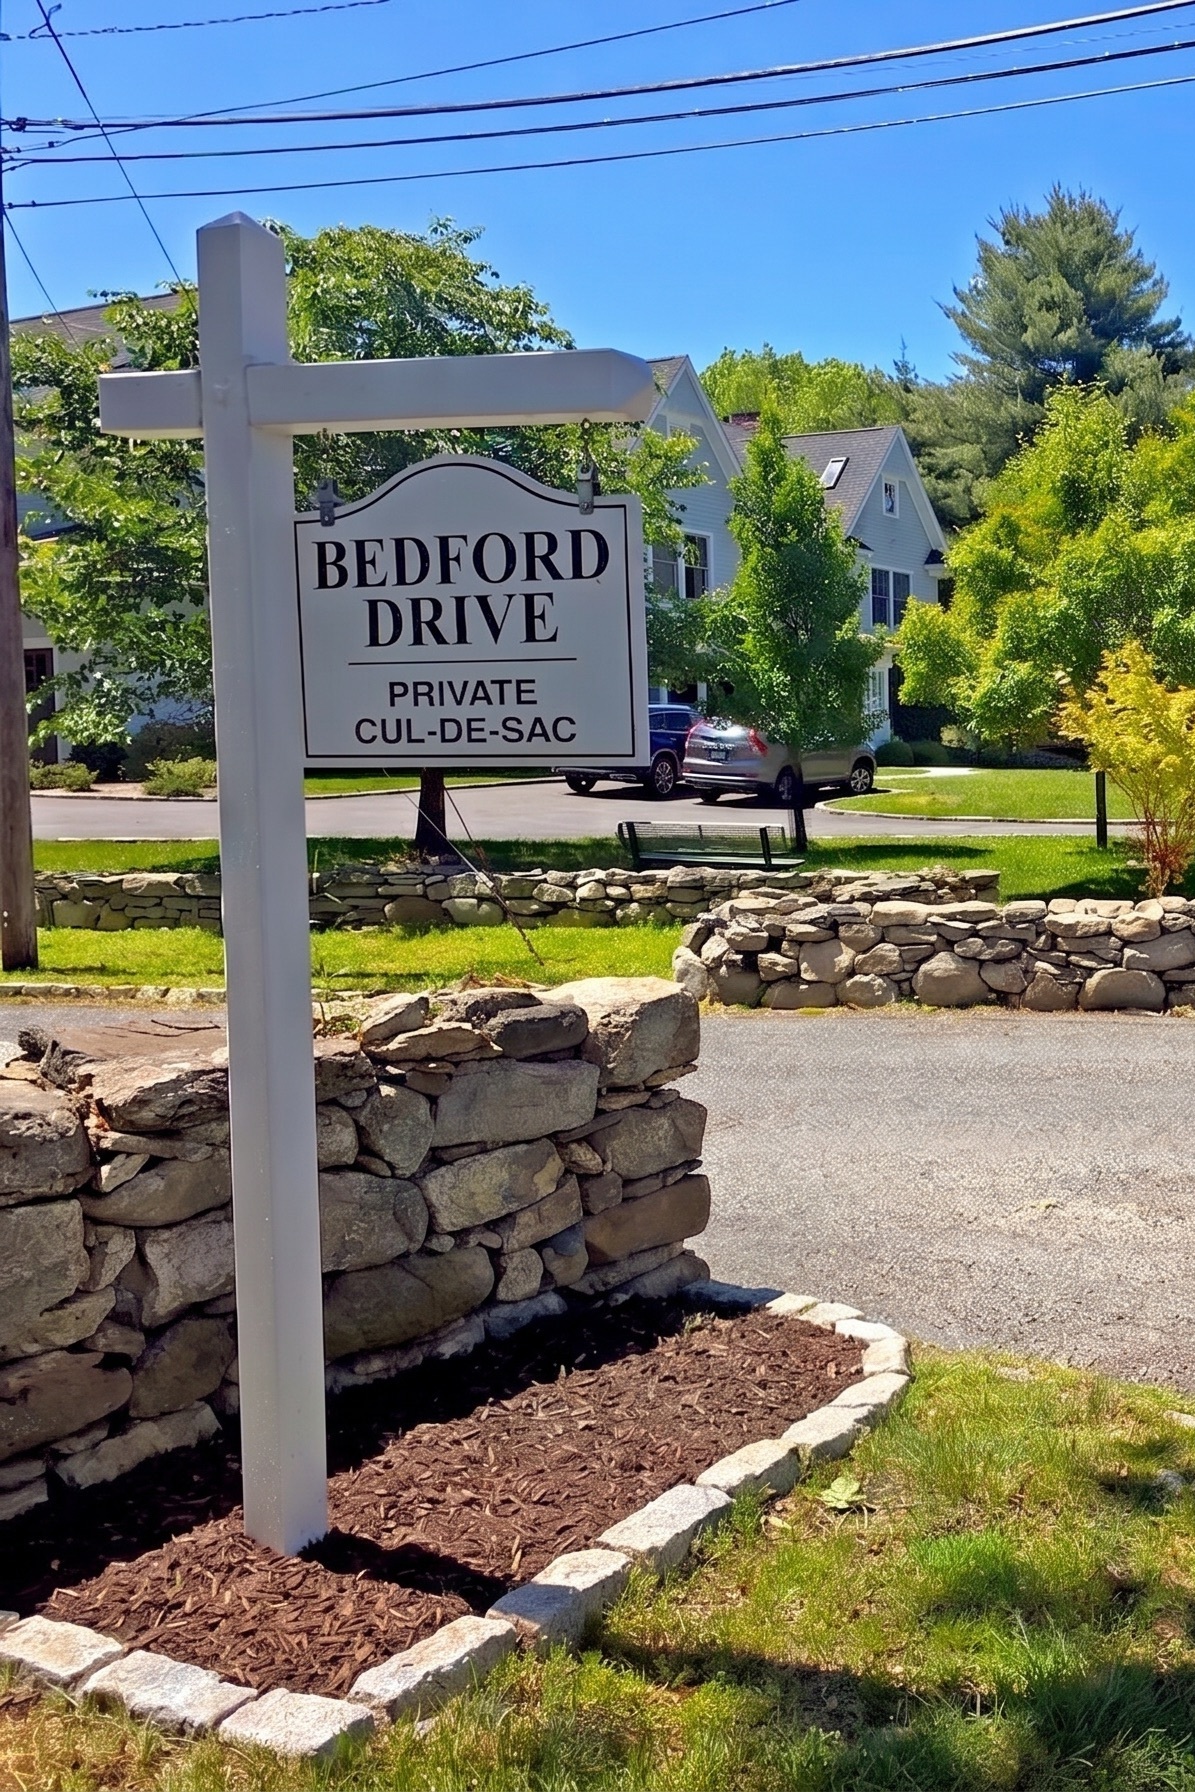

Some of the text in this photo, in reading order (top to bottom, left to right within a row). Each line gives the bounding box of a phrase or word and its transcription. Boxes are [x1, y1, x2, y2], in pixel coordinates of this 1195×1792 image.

[312, 529, 610, 590] BEDFORD
[362, 592, 559, 648] DRIVE
[388, 679, 538, 707] PRIVATE
[355, 716, 577, 744] CUL-DE-SAC
